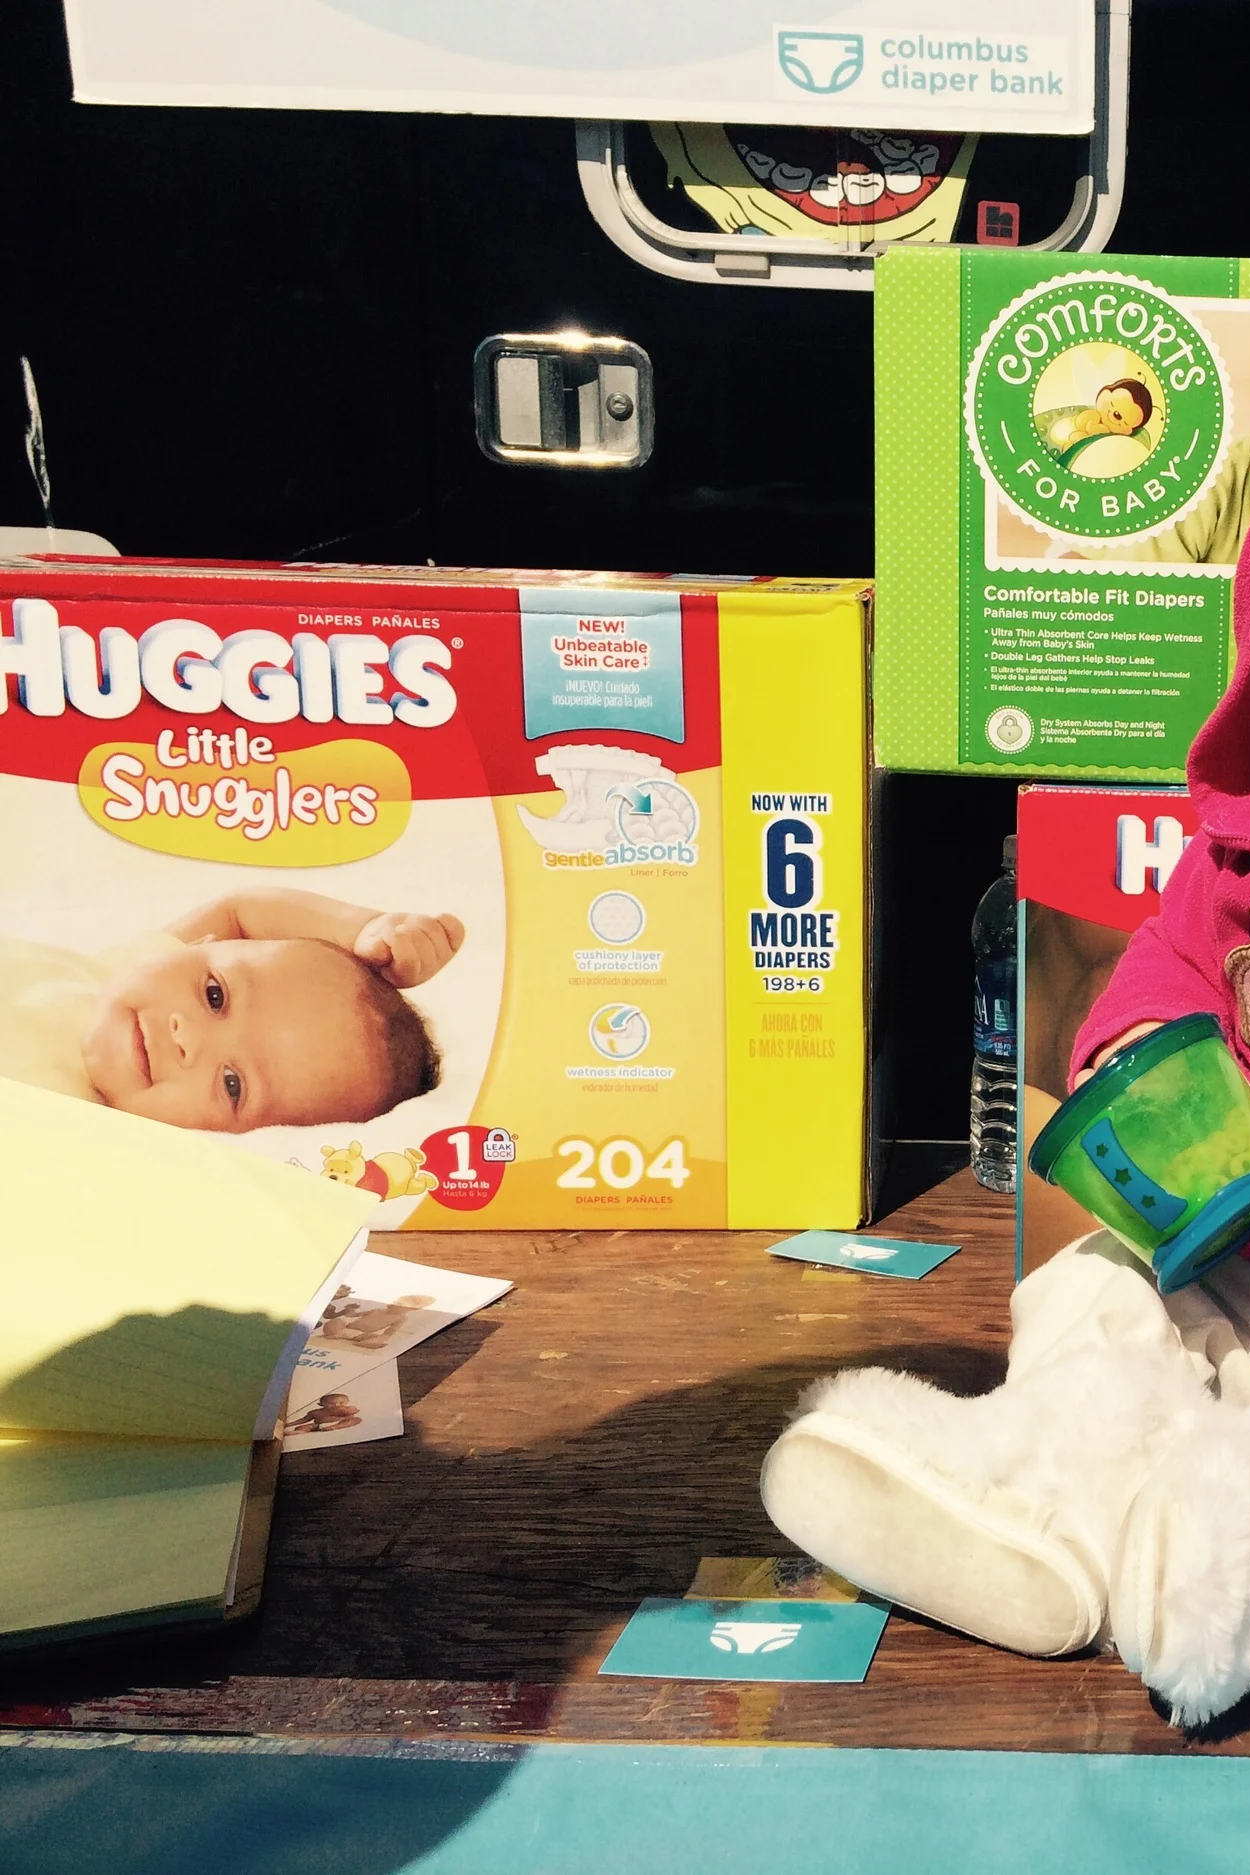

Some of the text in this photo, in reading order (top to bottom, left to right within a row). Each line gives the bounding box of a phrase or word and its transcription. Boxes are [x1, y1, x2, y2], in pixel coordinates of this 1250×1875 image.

[881, 34, 1028, 63] columbus
[882, 65, 1063, 95] diaper bank
[1017, 459, 1180, 517] FOR BABY
[984, 585, 1205, 610] Comfortable Fit Diapers
[298, 613, 440, 630] DIAPERS PAÑALES
[984, 607, 1114, 621] Pañales muy cómodos
[579, 619, 625, 633] NEW!
[991, 627, 1203, 642] Ultra Thin Absorbent Core Helps Keep Wetness
[554, 638, 648, 653] Unbeatable
[992, 638, 1017, 648] Away
[1019, 638, 1040, 647] from
[1075, 640, 1095, 649] Skin
[563, 654, 597, 667] Skin
[991, 652, 1155, 665] Double Leg Gathers Help Stop Leaks
[1040, 718, 1165, 730] Dry System Absorbs Day and Night
[157, 727, 276, 769] Little
[101, 752, 379, 840] Snugglers
[752, 794, 827, 812] NOW WITH
[766, 819, 814, 909] 6
[751, 912, 834, 948] MORE
[574, 950, 661, 962] cushiony layer
[755, 951, 831, 969] DIAPERS
[578, 960, 658, 971] of protection
[762, 977, 820, 991] 198+6
[761, 1013, 823, 1032] AHORA CON
[567, 1067, 673, 1077] wetness indicator
[486, 1143, 512, 1151] LEAK
[487, 1150, 512, 1158] LOCK
[447, 1131, 477, 1180] 1
[556, 1139, 691, 1189] 204
[442, 1181, 490, 1190] Up to 14 lb
[575, 1194, 673, 1204] DIAPERS PAÑALES
[296, 1358, 342, 1370] ank
